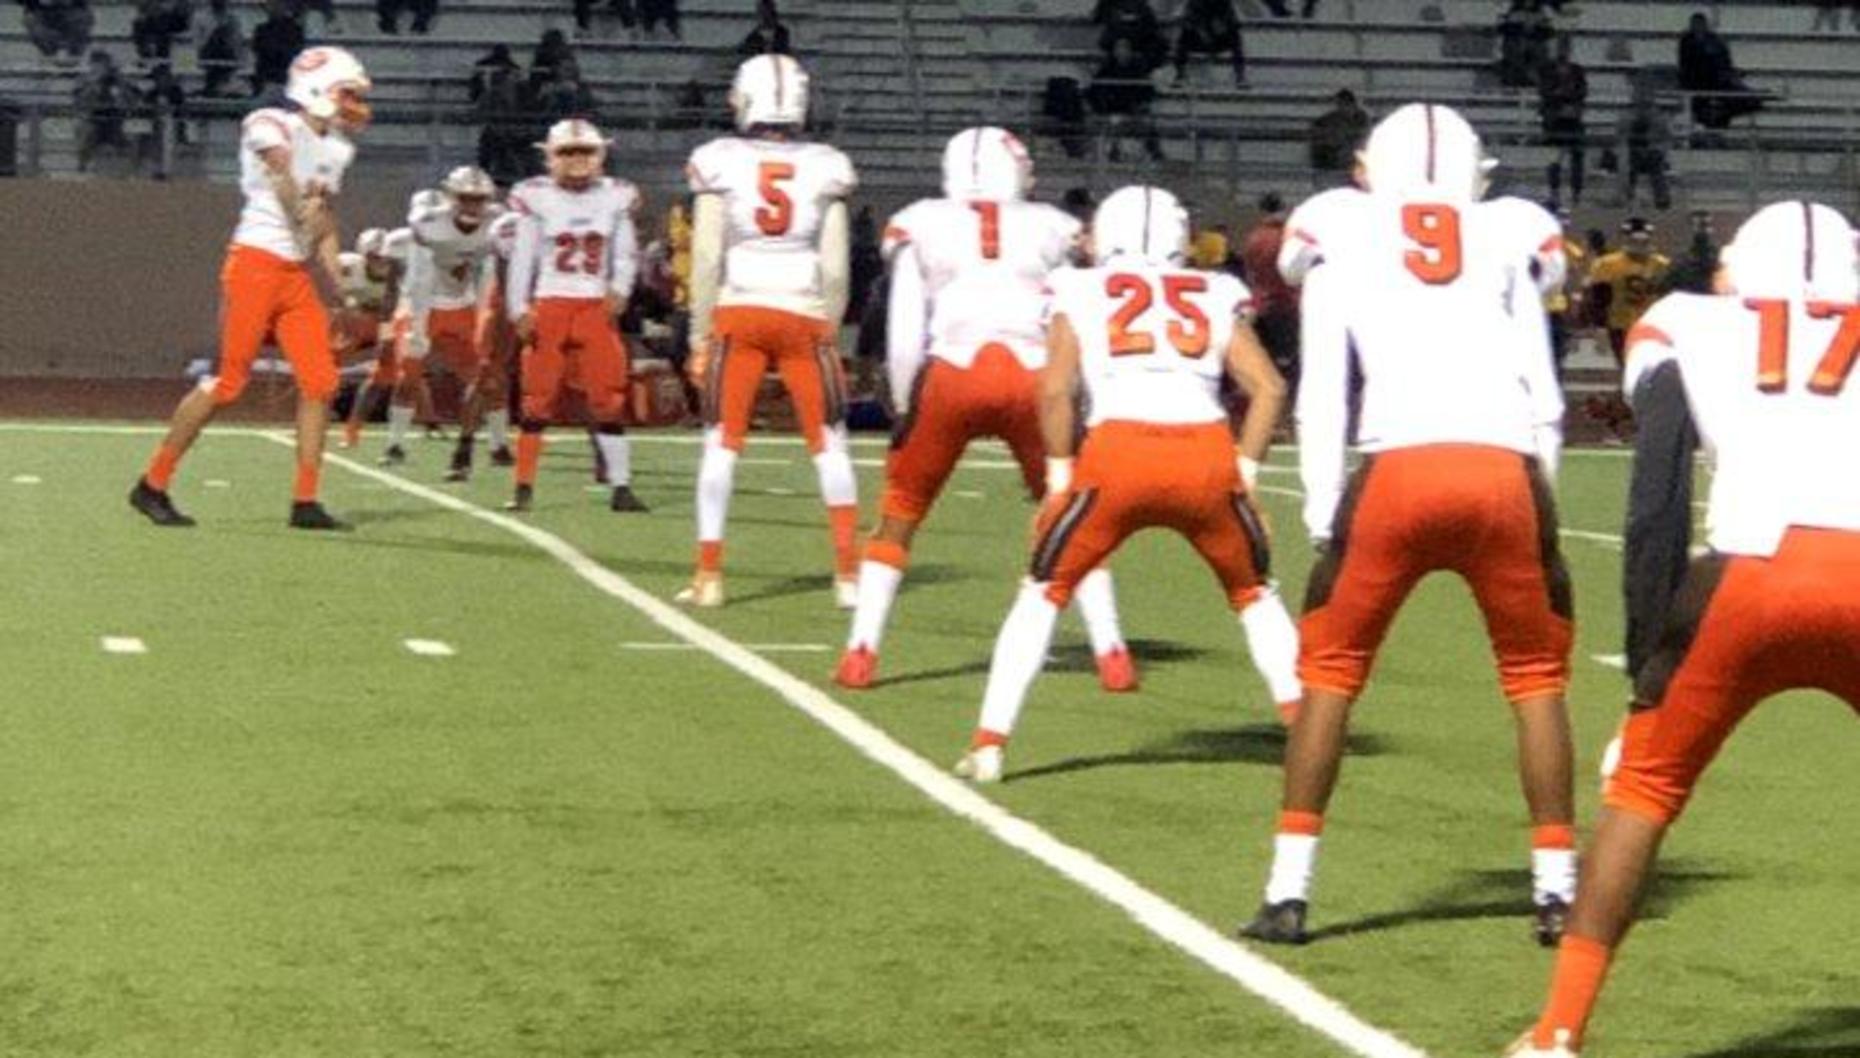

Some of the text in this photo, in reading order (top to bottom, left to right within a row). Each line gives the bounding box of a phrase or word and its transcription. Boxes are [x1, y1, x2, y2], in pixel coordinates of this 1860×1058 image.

[755, 161, 795, 236] 5
[968, 200, 999, 260] 1
[1401, 203, 1462, 285] 9
[1106, 273, 1211, 360] 25
[1743, 298, 1860, 396] 17
